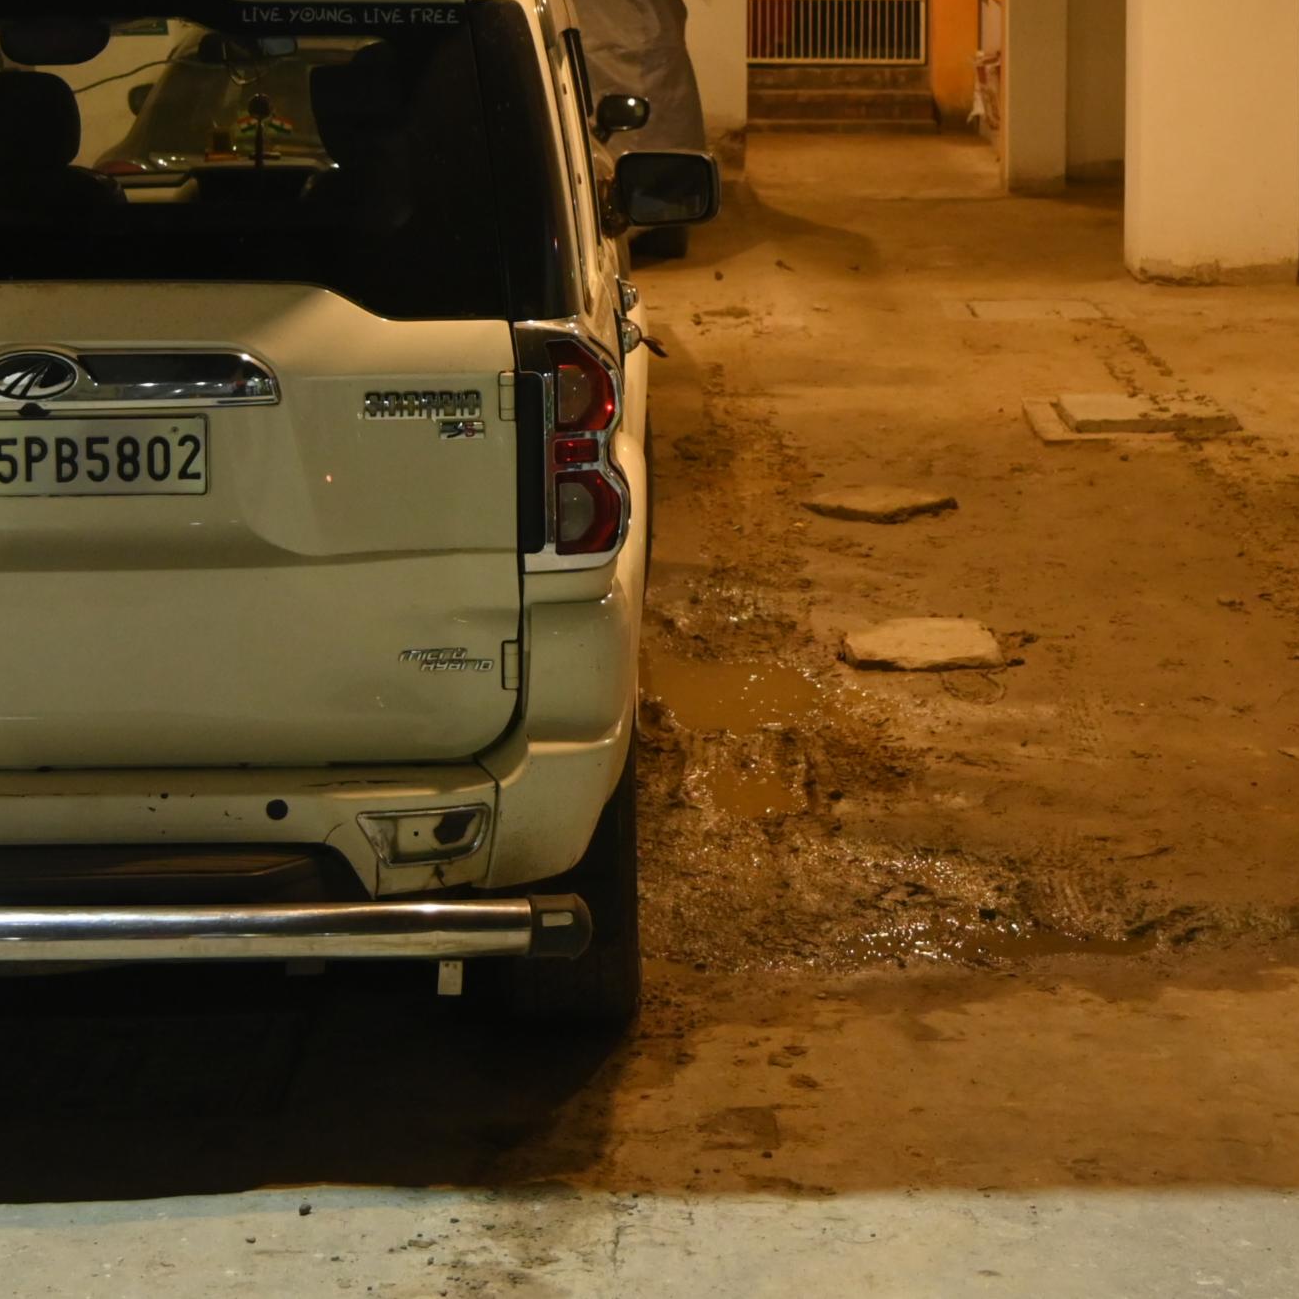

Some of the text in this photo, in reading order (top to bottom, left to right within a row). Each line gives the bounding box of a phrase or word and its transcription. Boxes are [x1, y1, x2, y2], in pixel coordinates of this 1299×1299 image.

[242, 6, 284, 23] LIVE
[363, 7, 404, 24] LIVE
[410, 7, 460, 25] FREE
